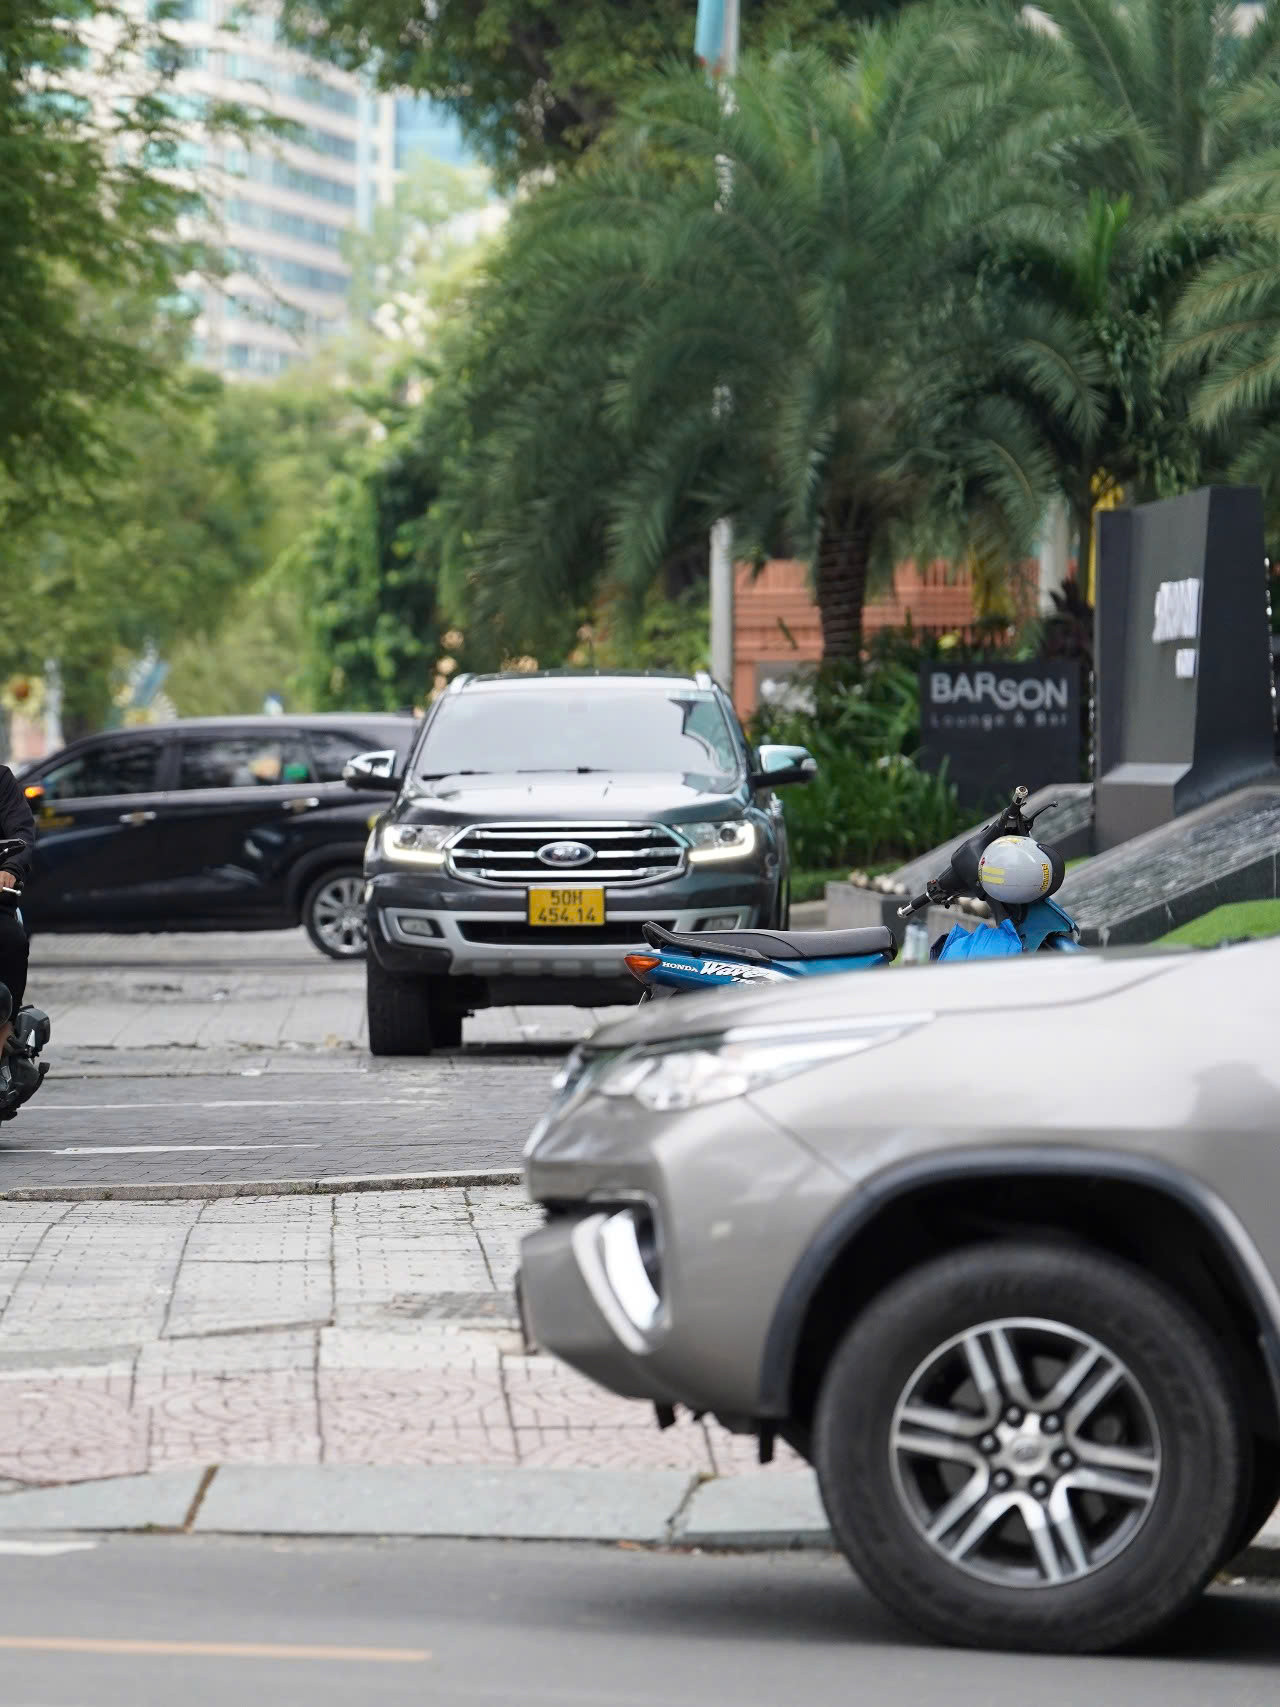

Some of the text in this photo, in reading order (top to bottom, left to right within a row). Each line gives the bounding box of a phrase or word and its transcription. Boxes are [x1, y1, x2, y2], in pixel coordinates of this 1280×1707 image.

[930, 671, 1068, 711] BARSON
[551, 890, 583, 906] 50H
[538, 908, 596, 922] 454.14
[662, 960, 762, 978] HONDA Wave
